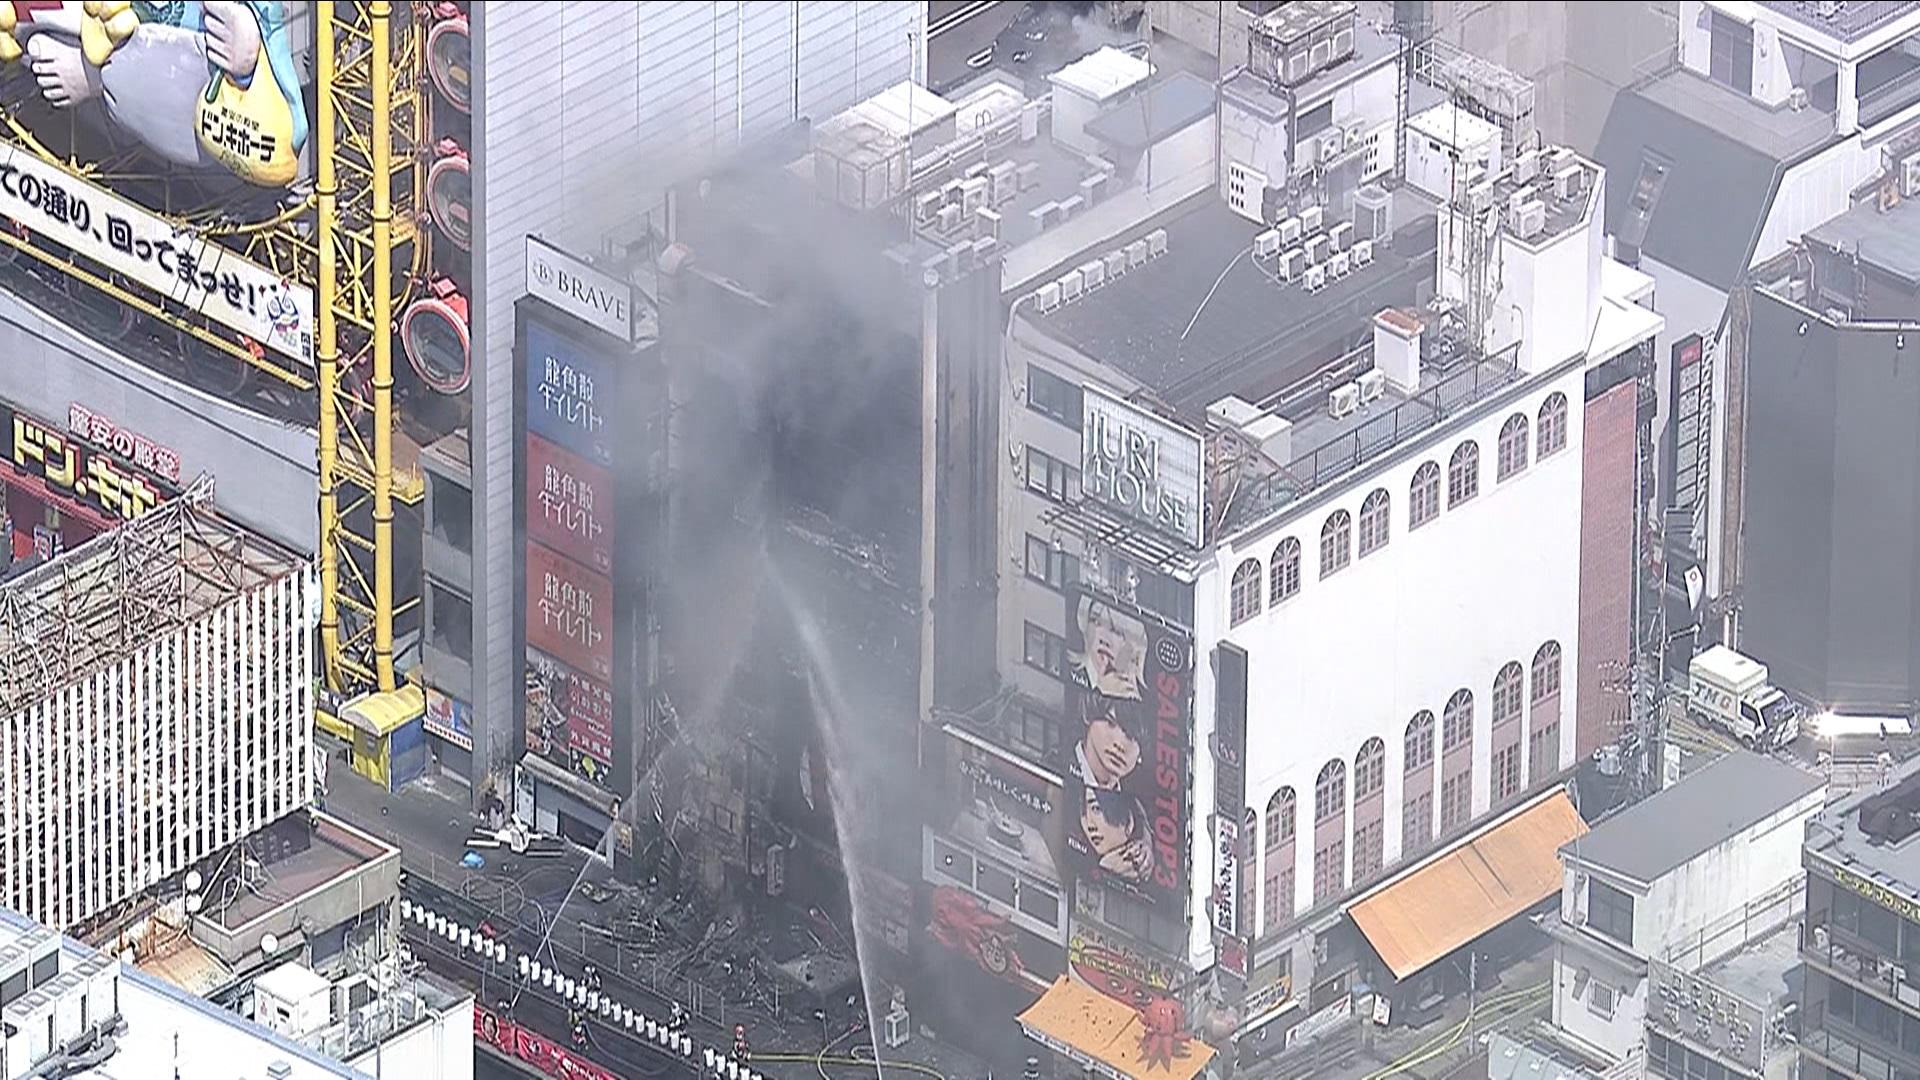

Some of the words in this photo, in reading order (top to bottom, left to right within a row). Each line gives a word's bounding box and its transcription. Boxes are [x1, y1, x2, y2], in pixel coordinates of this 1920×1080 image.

[558, 269, 625, 322] BRAVE
[545, 355, 594, 403] 龍角散
[538, 382, 603, 432] ダイレクト
[545, 463, 593, 512] 龍角散
[1095, 455, 1189, 533] HOUSE
[538, 490, 602, 540] ダイレクト
[545, 572, 592, 619] 龍角散
[538, 597, 602, 648] ダイレクト
[1154, 796, 1179, 890] TOP3
